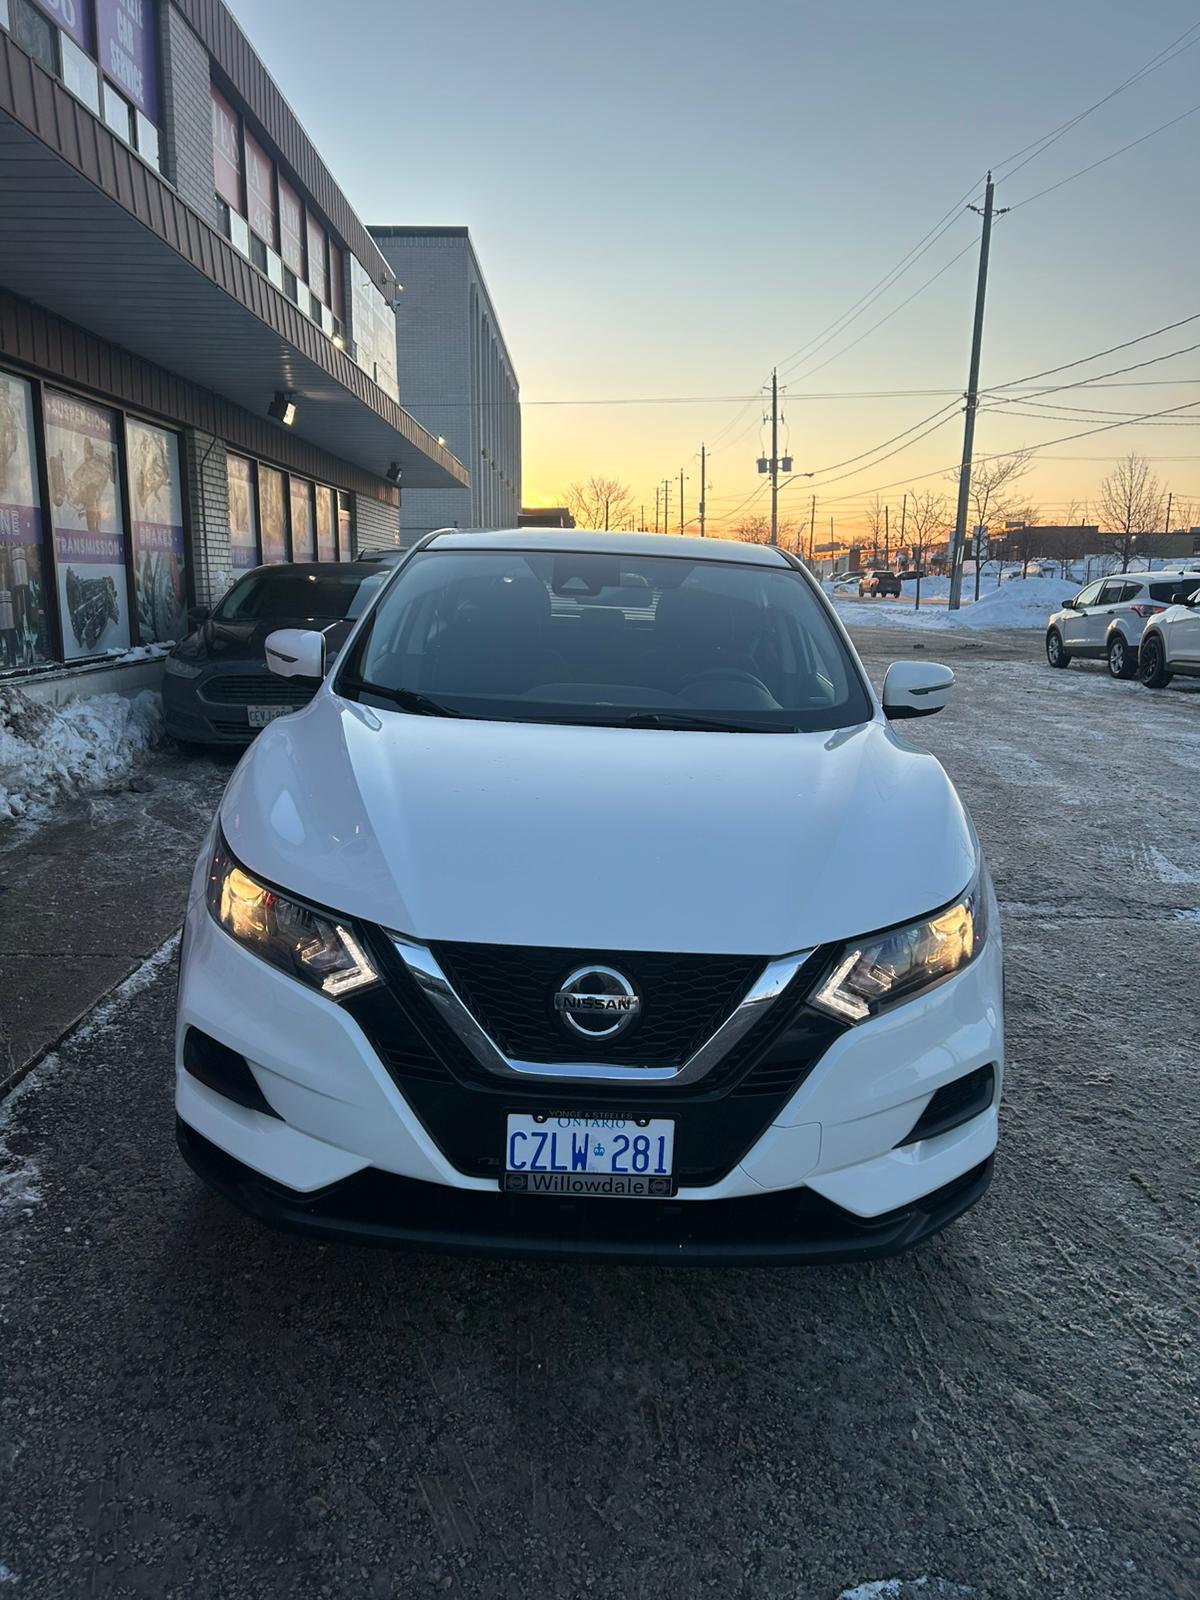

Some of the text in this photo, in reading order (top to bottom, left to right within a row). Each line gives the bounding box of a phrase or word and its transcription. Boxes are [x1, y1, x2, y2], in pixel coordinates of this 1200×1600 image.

[120, 0, 143, 30] ITE
[117, 8, 134, 57] CAR
[110, 38, 143, 104] SERVICE
[51, 400, 107, 432] SUSPENSION
[56, 536, 120, 556] TRANSMISSION
[141, 526, 172, 548] BRAKES
[563, 996, 631, 1011] NISSAN
[549, 1110, 580, 1118] YONGE
[592, 1111, 633, 1120] STEELES
[557, 1118, 626, 1129] ONTARIO
[509, 1131, 667, 1174] CZLW 281
[534, 1174, 644, 1194] Willowdale
